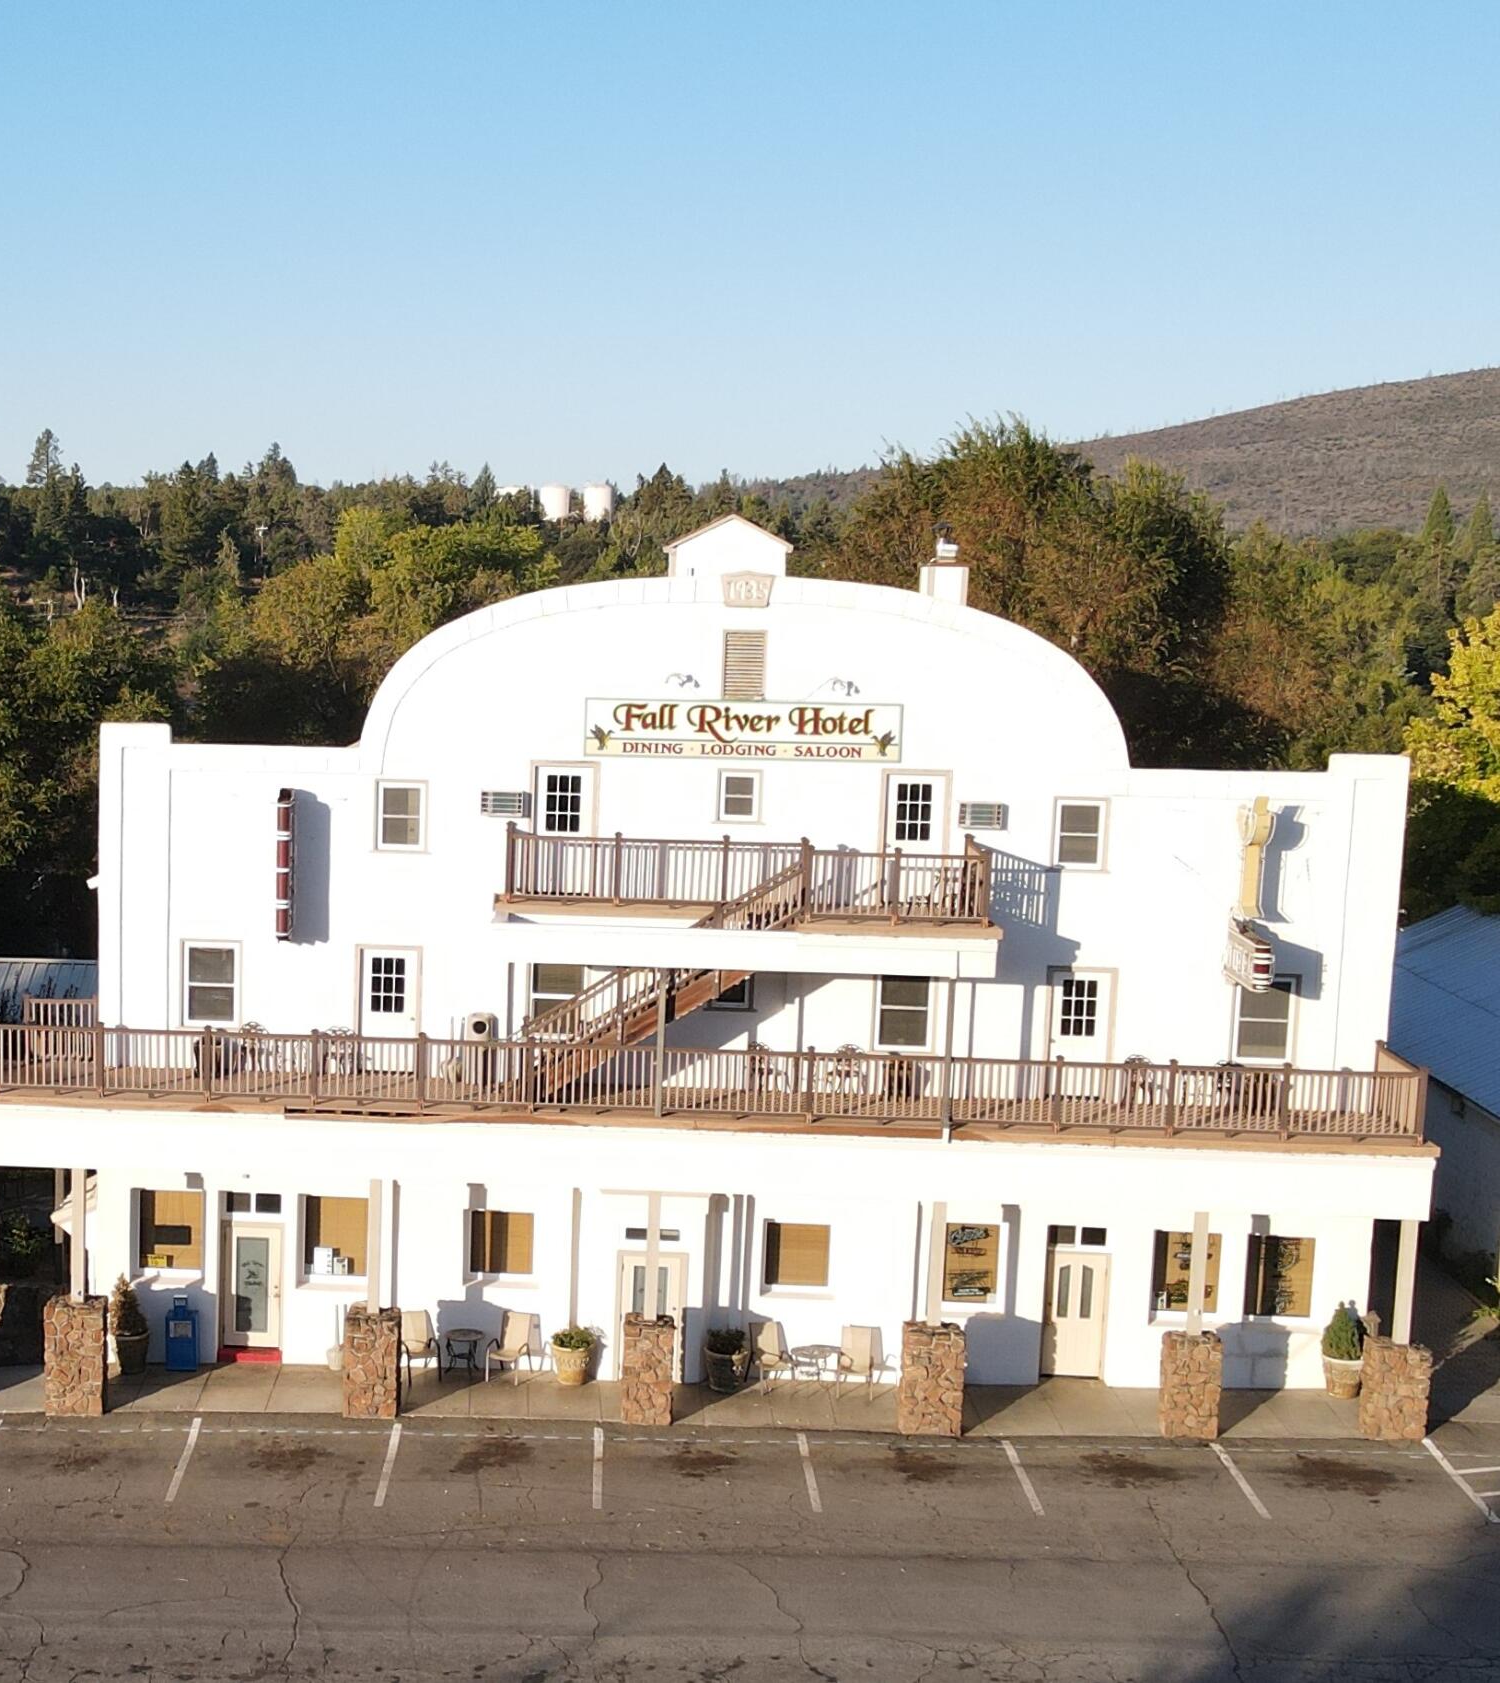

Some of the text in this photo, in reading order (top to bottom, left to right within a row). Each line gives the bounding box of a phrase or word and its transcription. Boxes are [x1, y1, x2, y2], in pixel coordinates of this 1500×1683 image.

[726, 579, 769, 600] 1935
[613, 703, 875, 744] Fall River Hotel
[622, 742, 862, 759] DINING LODGING SALOON
